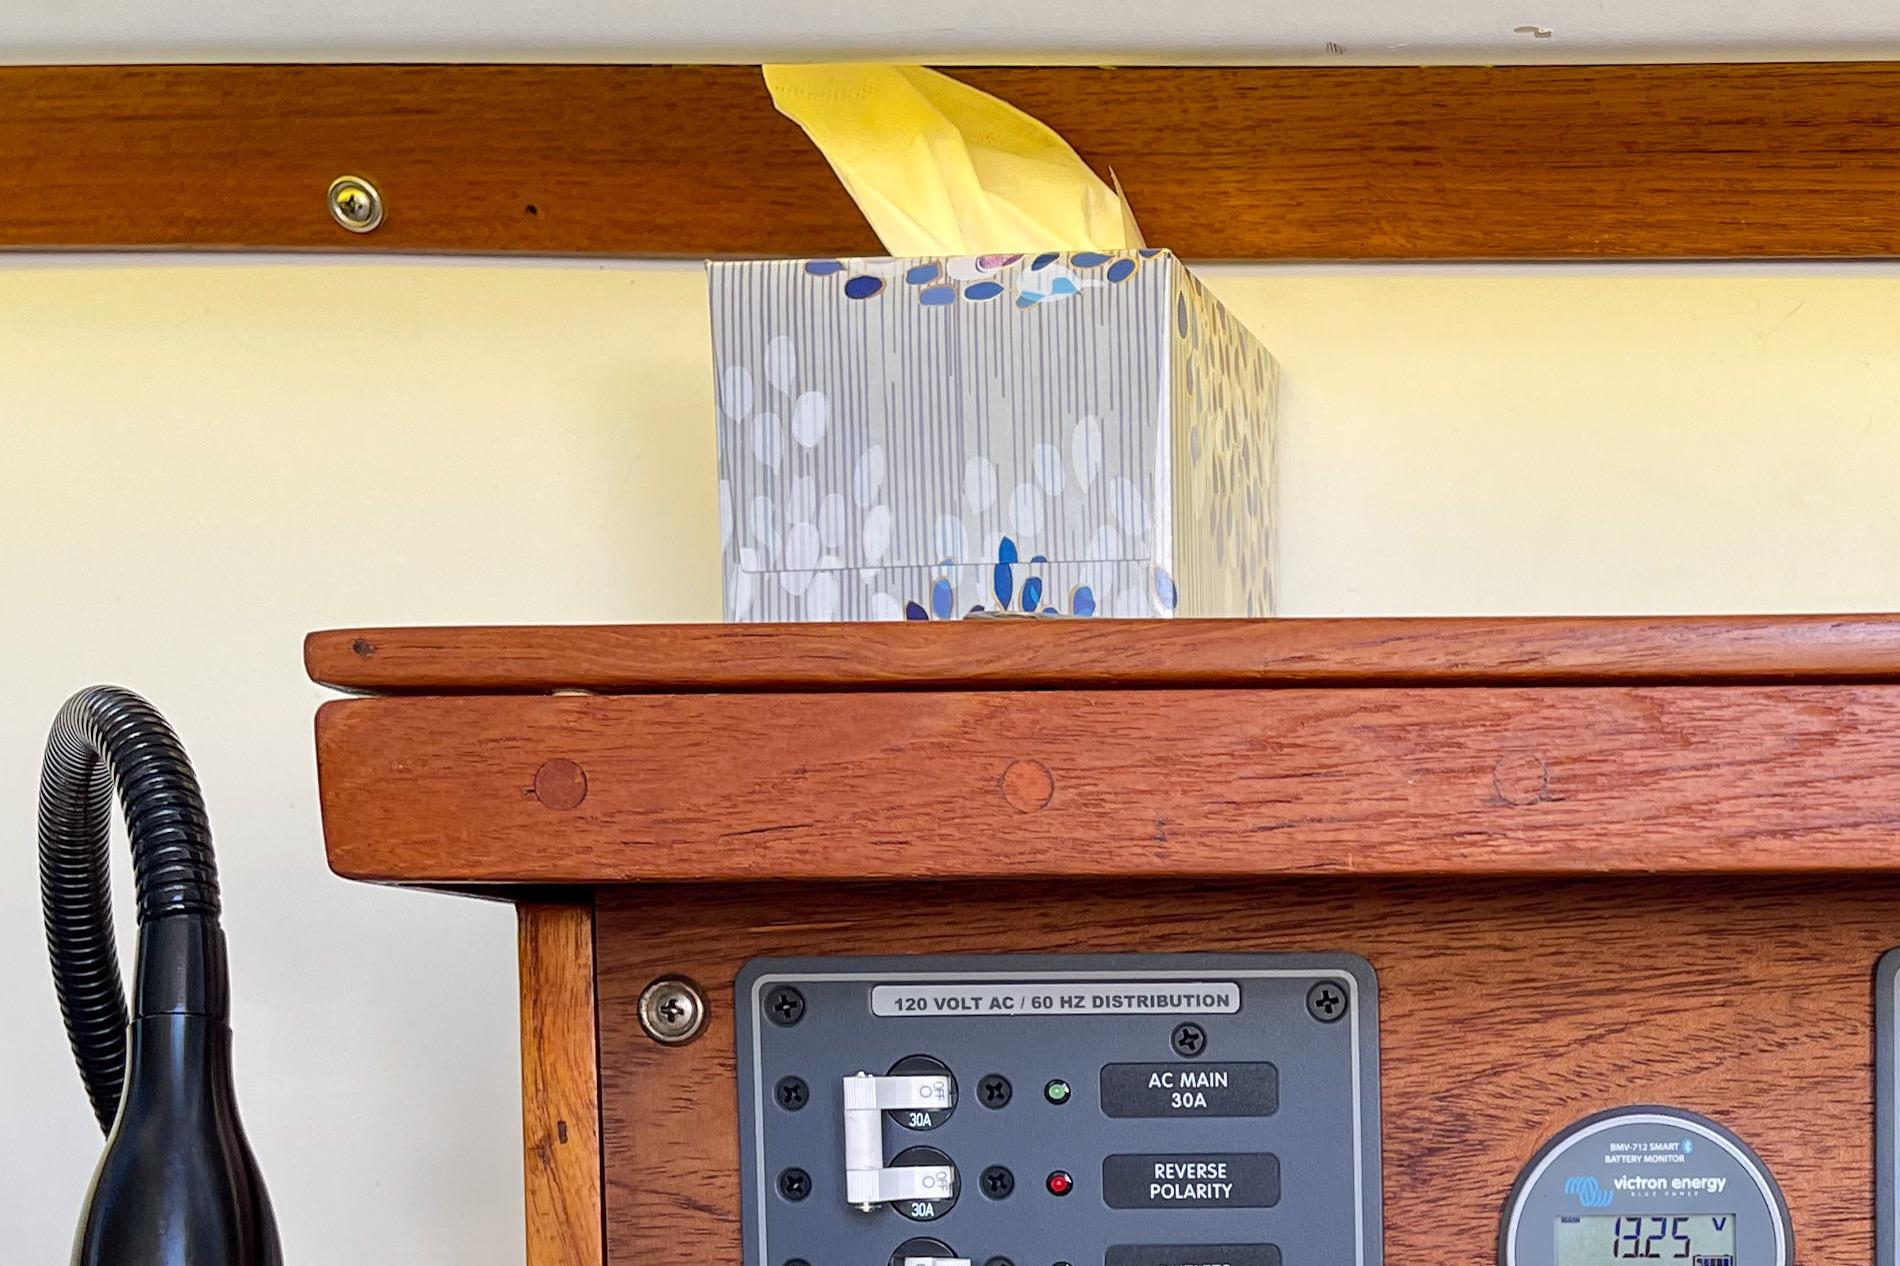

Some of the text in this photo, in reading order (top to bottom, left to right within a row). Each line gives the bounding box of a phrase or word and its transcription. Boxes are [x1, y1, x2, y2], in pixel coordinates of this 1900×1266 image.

[895, 994, 1230, 1011] 120 VOLT AC / 60 HZ DISTRIBUTION
[1148, 1072, 1228, 1088] AC MAIN
[933, 1081, 945, 1100] OFF
[1171, 1092, 1207, 1108] 30A
[909, 1112, 932, 1127] 30A
[1610, 1142, 1680, 1151] BMV-712 SMART
[1605, 1154, 1685, 1164] BATTERY MONITOR
[1154, 1163, 1227, 1179] REVERSE
[935, 1171, 948, 1191] OFF
[1614, 1175, 1727, 1193] victron energy
[1150, 1183, 1233, 1199] POLARITY
[911, 1202, 934, 1217] 30A
[1613, 1217, 1727, 1259] 13.25 V
